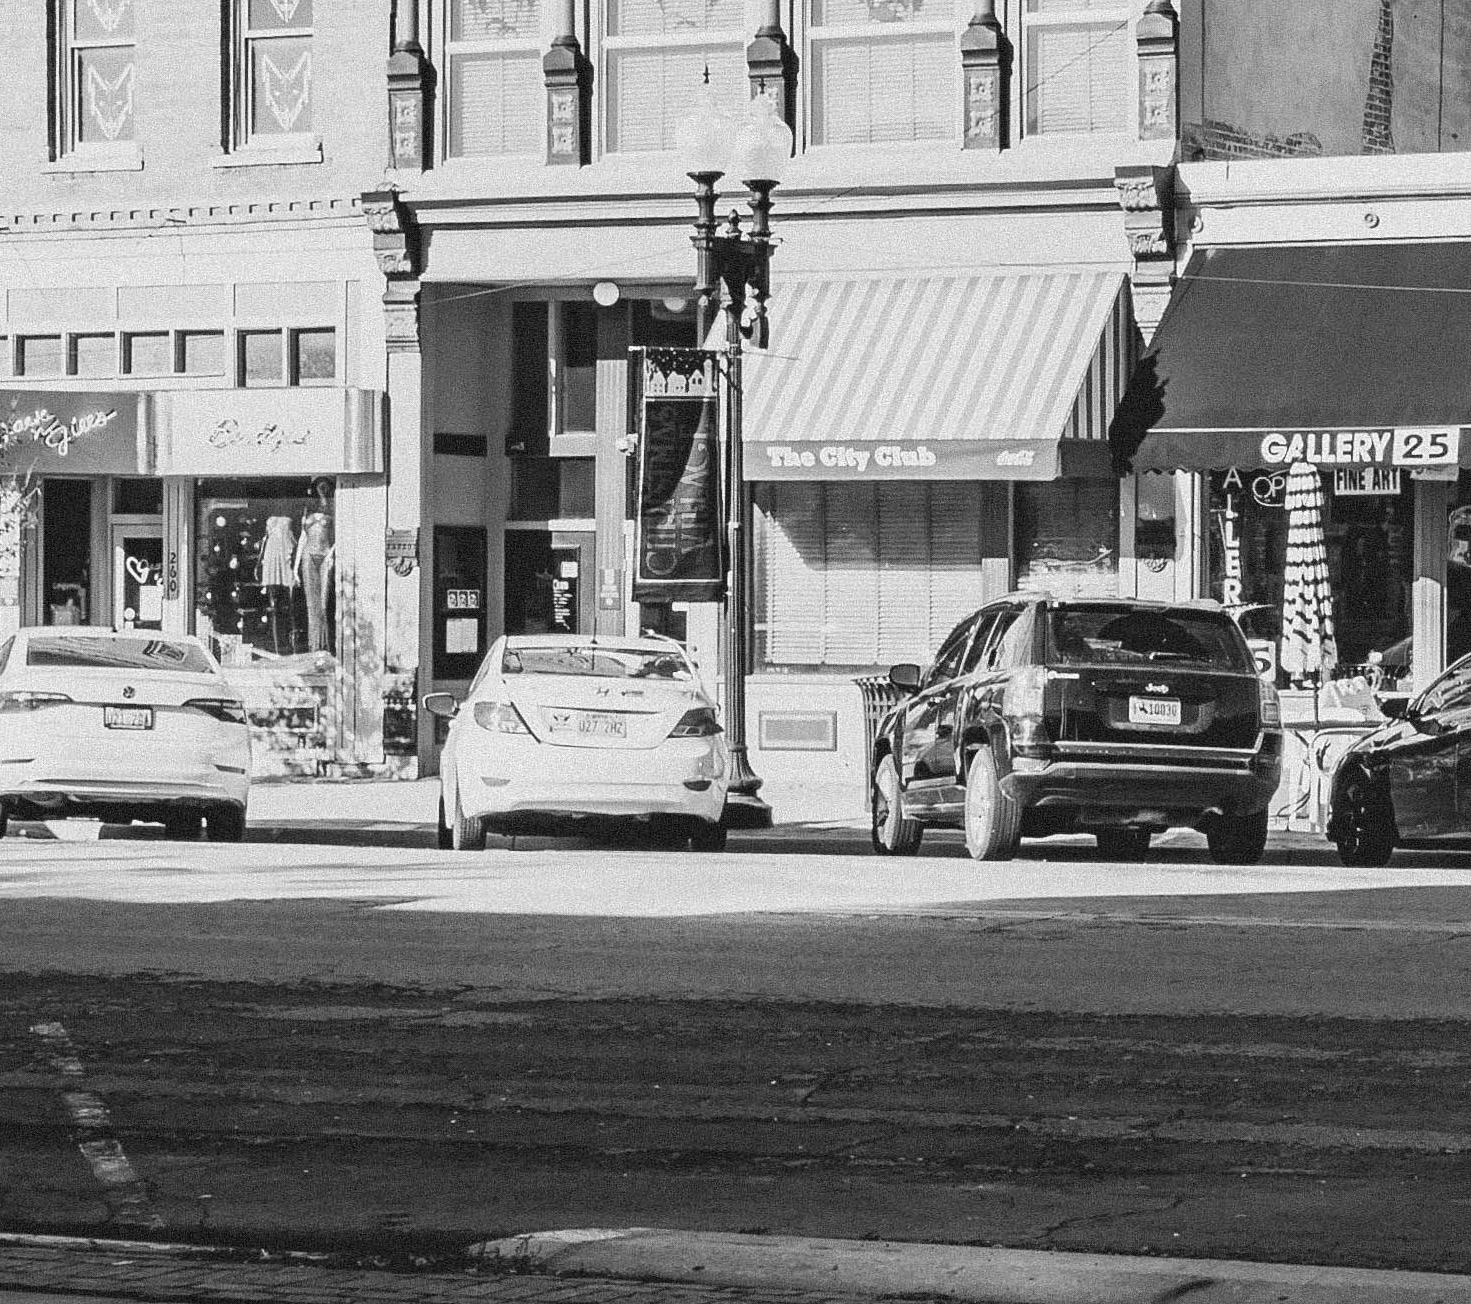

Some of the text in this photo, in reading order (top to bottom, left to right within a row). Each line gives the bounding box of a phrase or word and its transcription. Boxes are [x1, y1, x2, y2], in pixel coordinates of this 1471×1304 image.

[766, 446, 937, 472] The City Club
[1261, 433, 1449, 463] GALLERY 25
[1337, 469, 1367, 491] FINE
[1373, 468, 1399, 490] ART
[169, 552, 178, 592] 260
